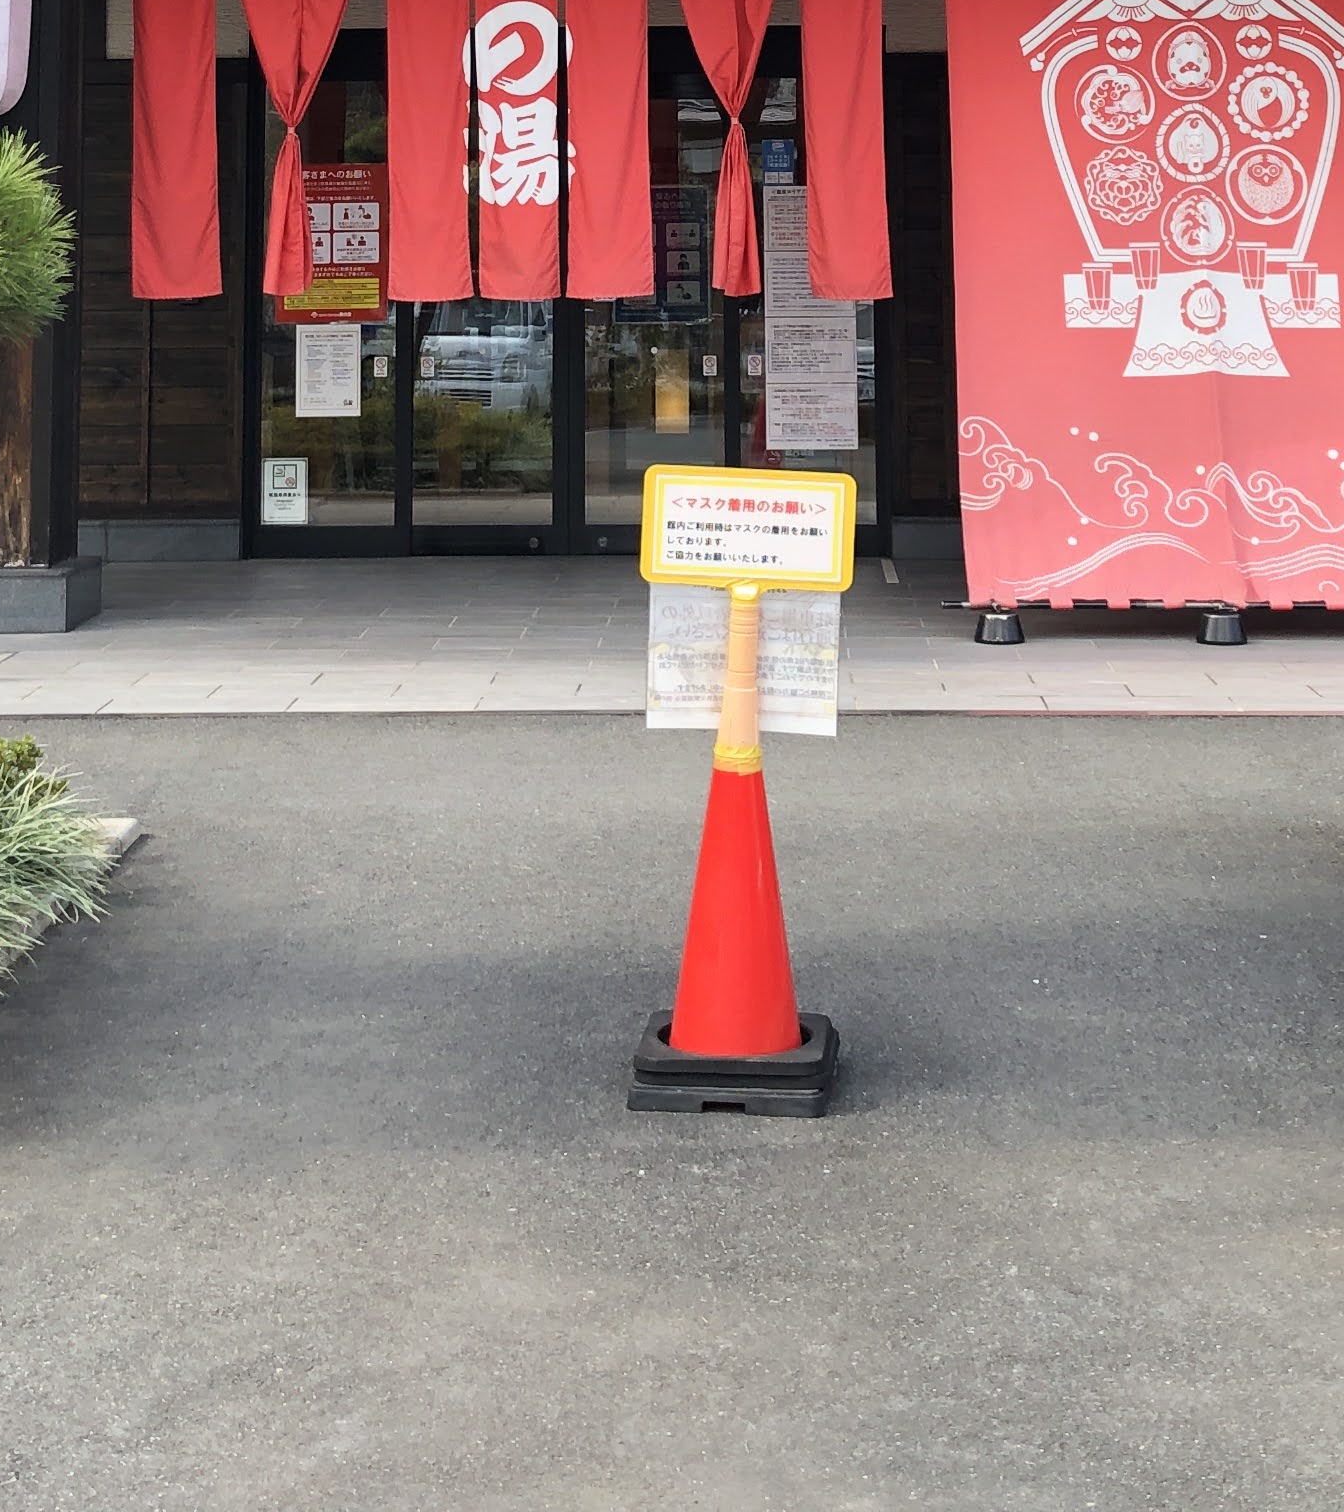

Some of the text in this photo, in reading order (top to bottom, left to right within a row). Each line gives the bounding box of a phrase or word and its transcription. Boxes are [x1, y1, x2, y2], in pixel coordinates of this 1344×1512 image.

[671, 496, 827, 515] ＜マスク着用のお願い＞
[667, 520, 828, 536] 館内ご利用時はマスクの着用をお願い
[667, 535, 727, 547] しております。
[666, 550, 783, 565] ご協力をお願いいたします。
